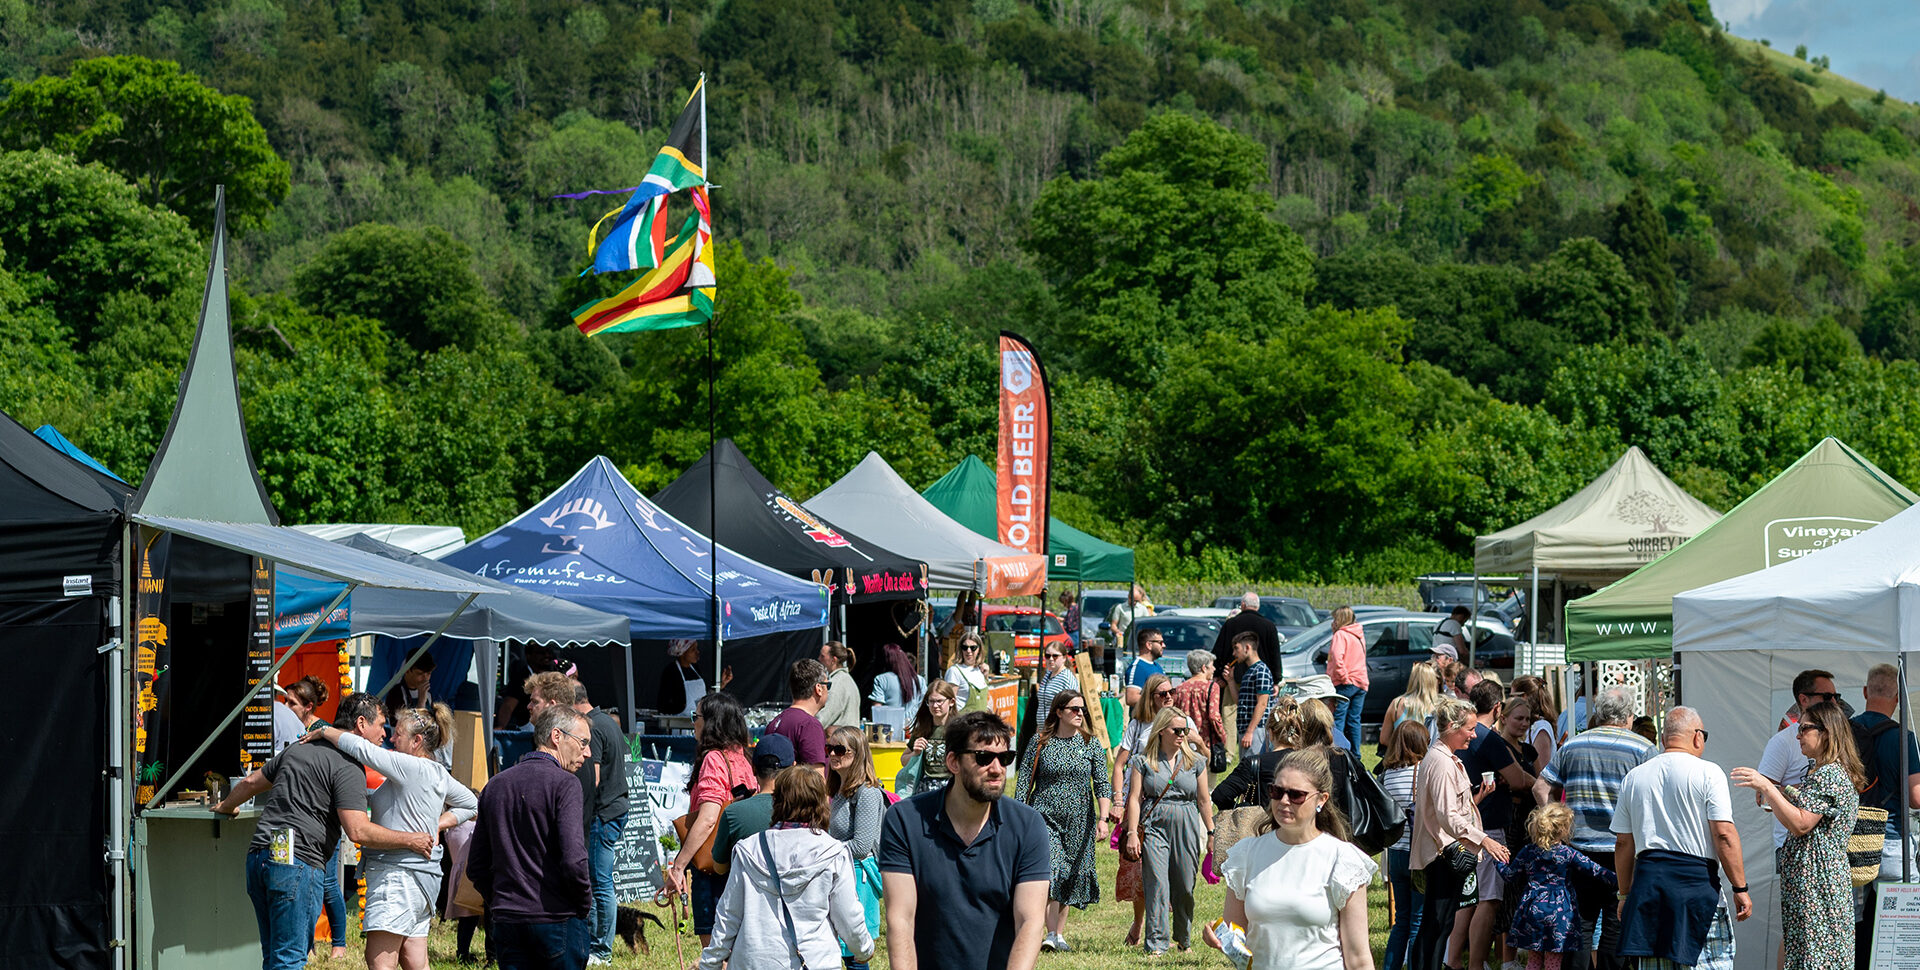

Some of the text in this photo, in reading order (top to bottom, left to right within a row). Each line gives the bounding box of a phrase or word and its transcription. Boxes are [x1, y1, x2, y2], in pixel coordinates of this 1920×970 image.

[1007, 401, 1035, 552] OLD BEER
[1782, 526, 1865, 538] Vineyar
[1628, 536, 1675, 552] SURREY
[1813, 538, 1829, 547] of
[474, 559, 626, 584] Afromufasa
[862, 573, 883, 594] Waffle
[883, 571, 893, 592] On
[898, 571, 915, 591] stick
[750, 600, 802, 622] Taste Of Africa
[648, 791, 676, 810] NU
